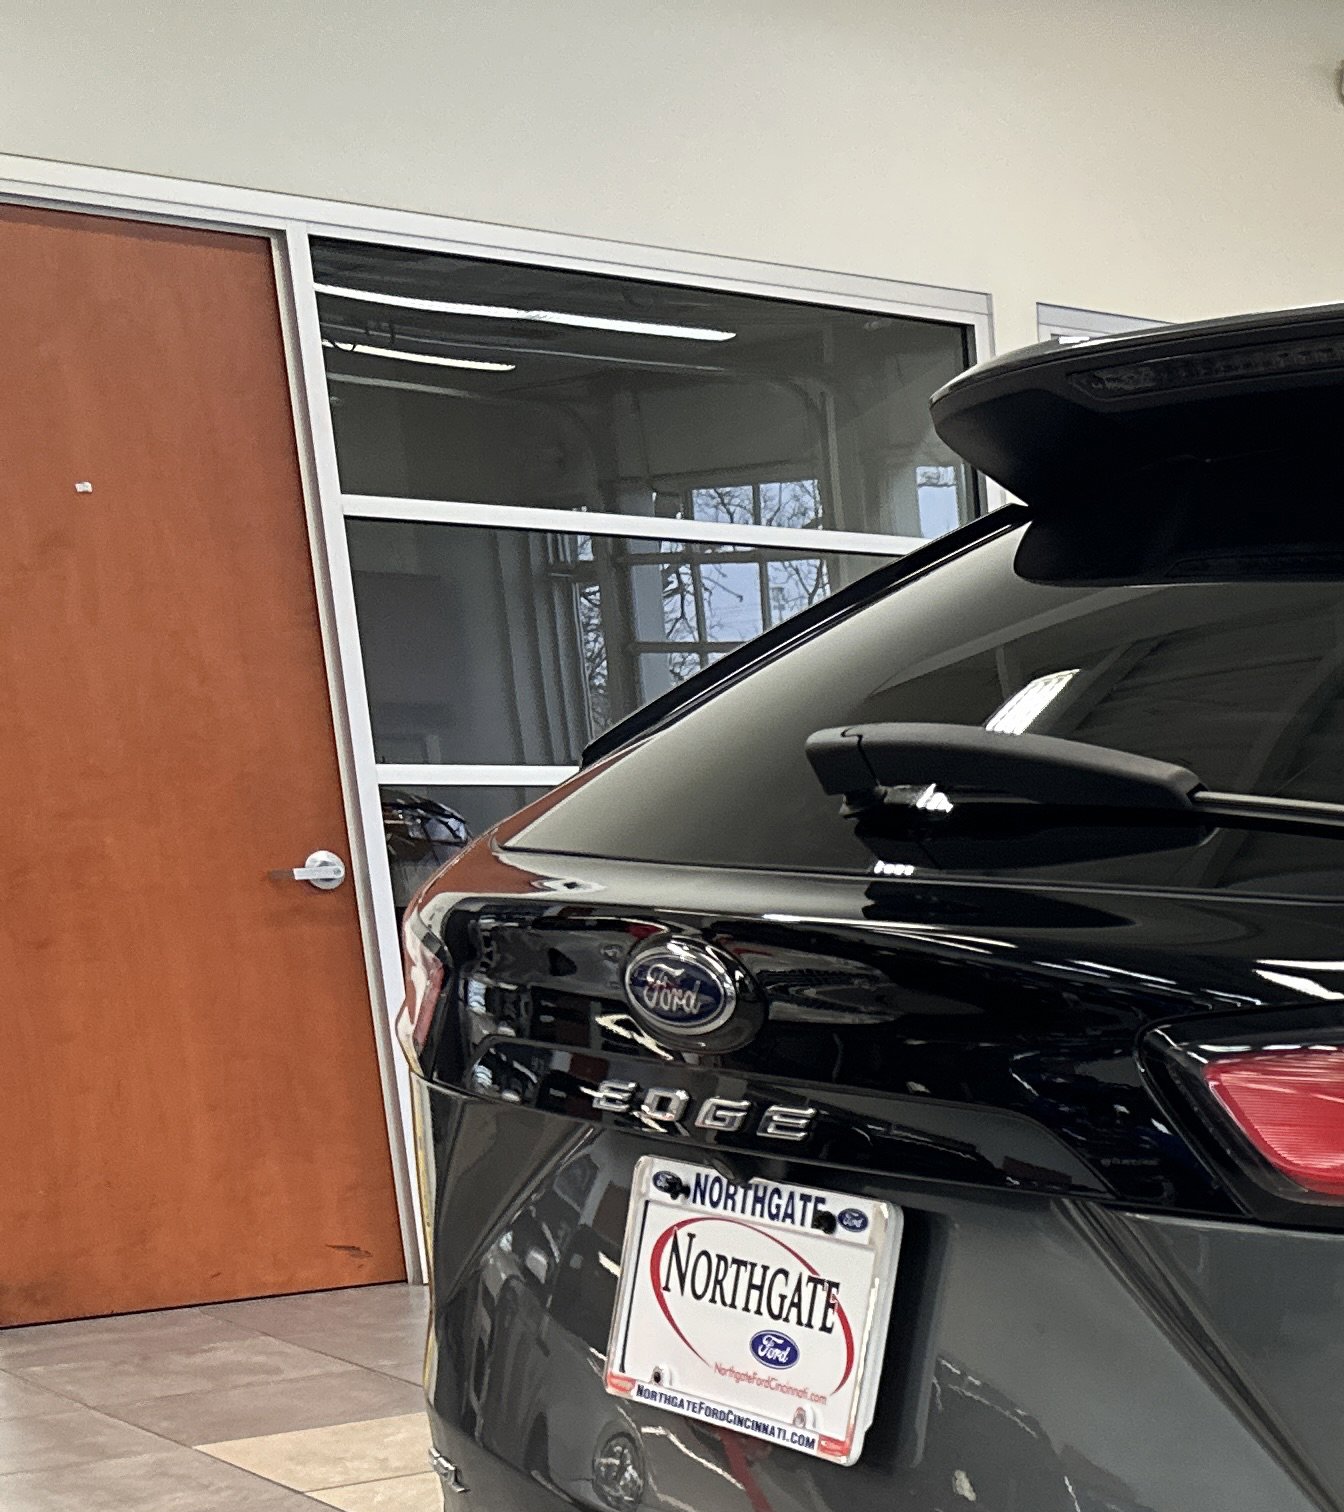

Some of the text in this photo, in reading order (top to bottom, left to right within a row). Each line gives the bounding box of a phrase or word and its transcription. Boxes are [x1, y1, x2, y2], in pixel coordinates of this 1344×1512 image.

[643, 963, 701, 1015] Ford
[592, 1078, 818, 1141] EDGE
[758, 1334, 790, 1364] Ford
